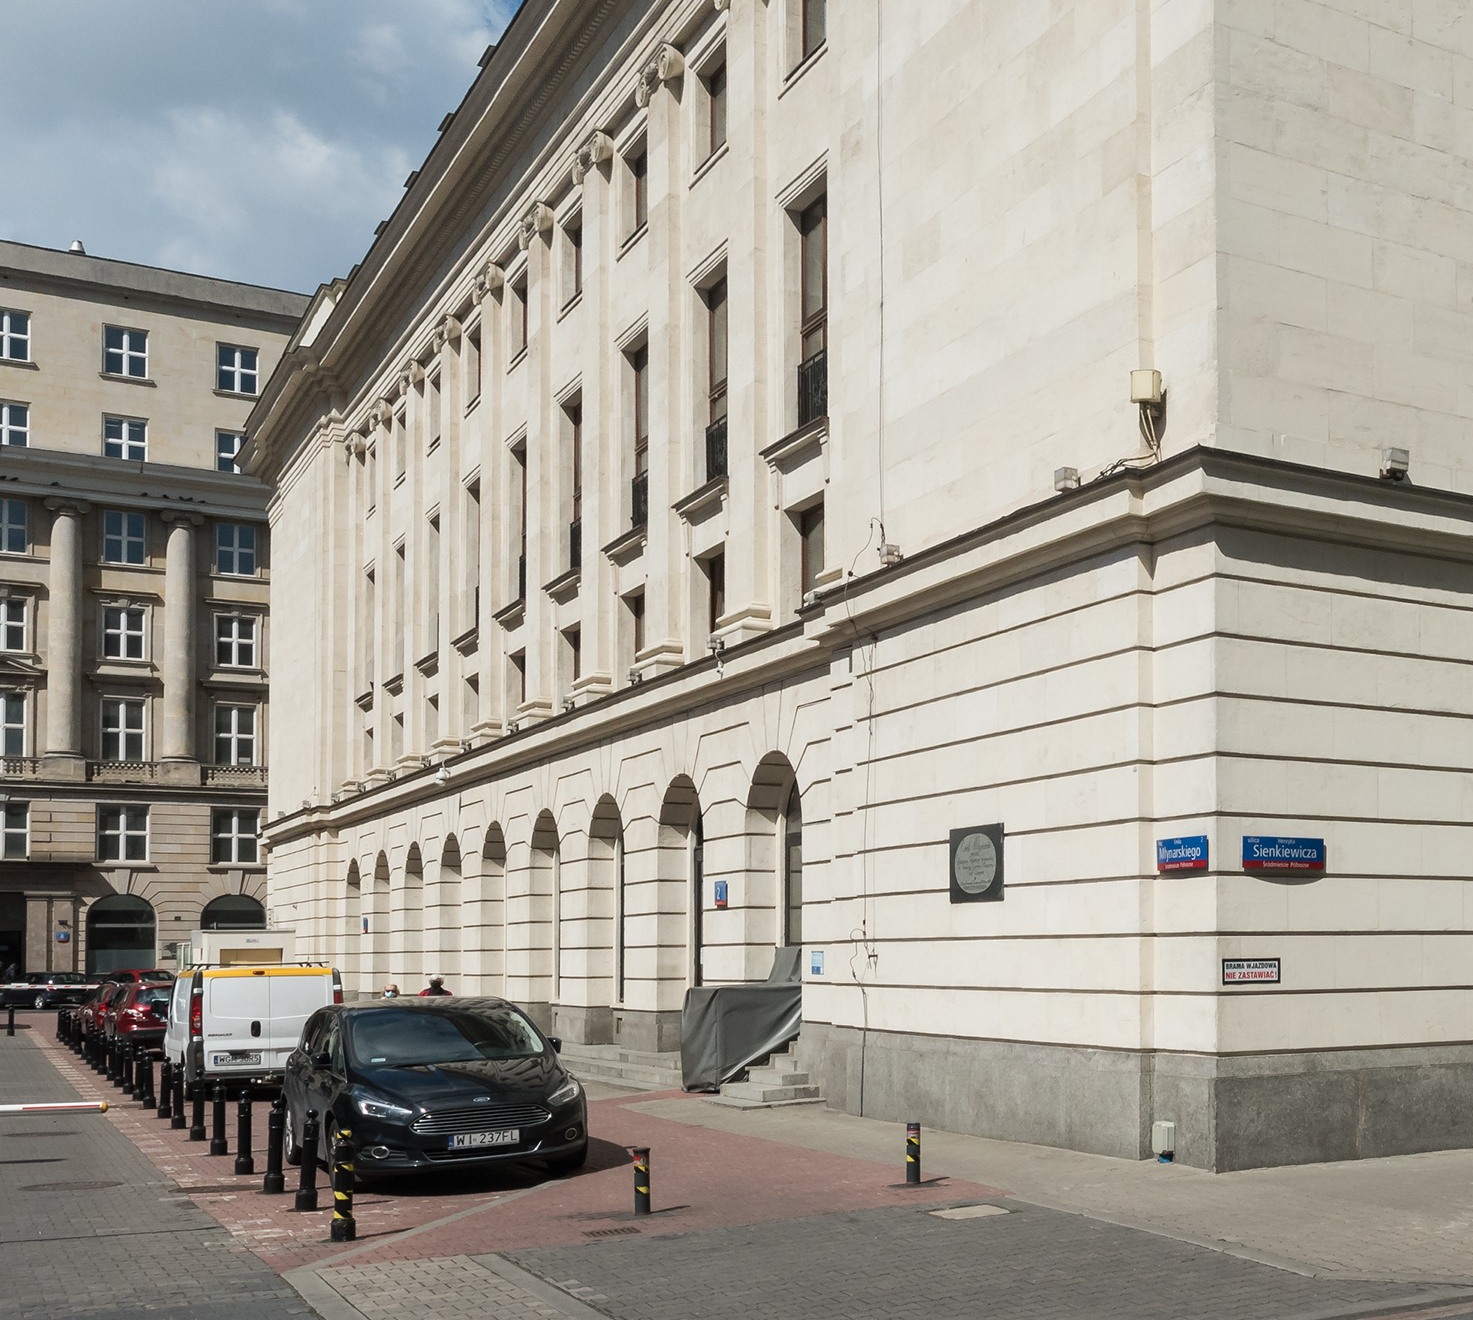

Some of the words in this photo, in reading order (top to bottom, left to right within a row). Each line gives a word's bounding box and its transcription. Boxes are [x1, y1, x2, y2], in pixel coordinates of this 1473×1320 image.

[1159, 845, 1201, 862] Młynarskiego
[1253, 844, 1317, 859] Sienkiewicza
[716, 887, 721, 900] 2
[456, 1134, 473, 1146] WI
[479, 1131, 518, 1144] 237FL
